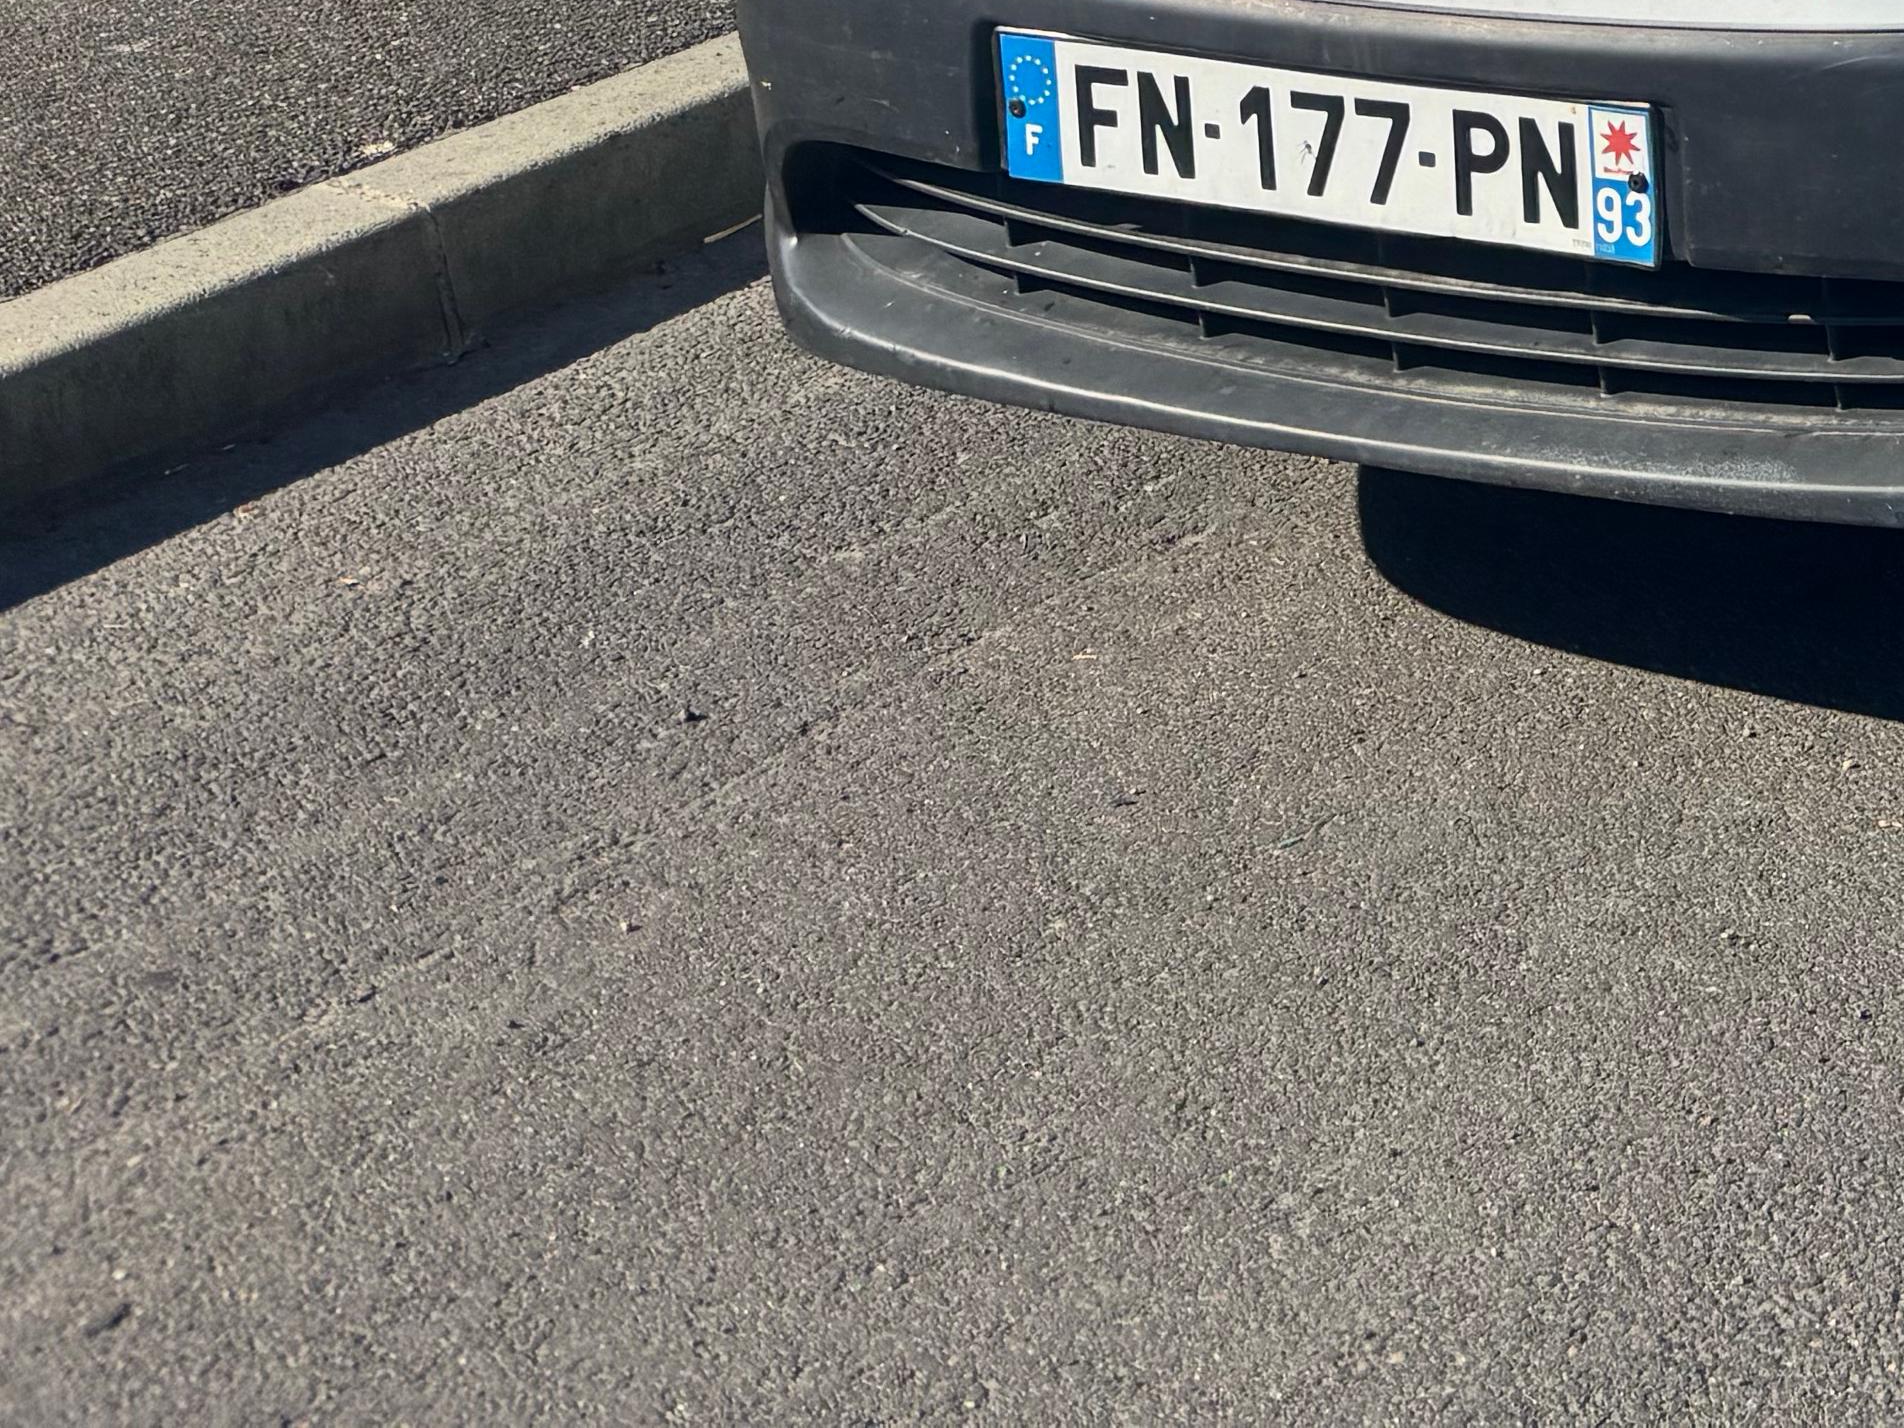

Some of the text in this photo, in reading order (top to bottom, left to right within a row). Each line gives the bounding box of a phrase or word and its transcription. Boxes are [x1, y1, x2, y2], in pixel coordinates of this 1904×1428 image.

[1025, 123, 1043, 156] F
[1074, 63, 1579, 230] FN-177-PN
[1596, 186, 1651, 247] 93
